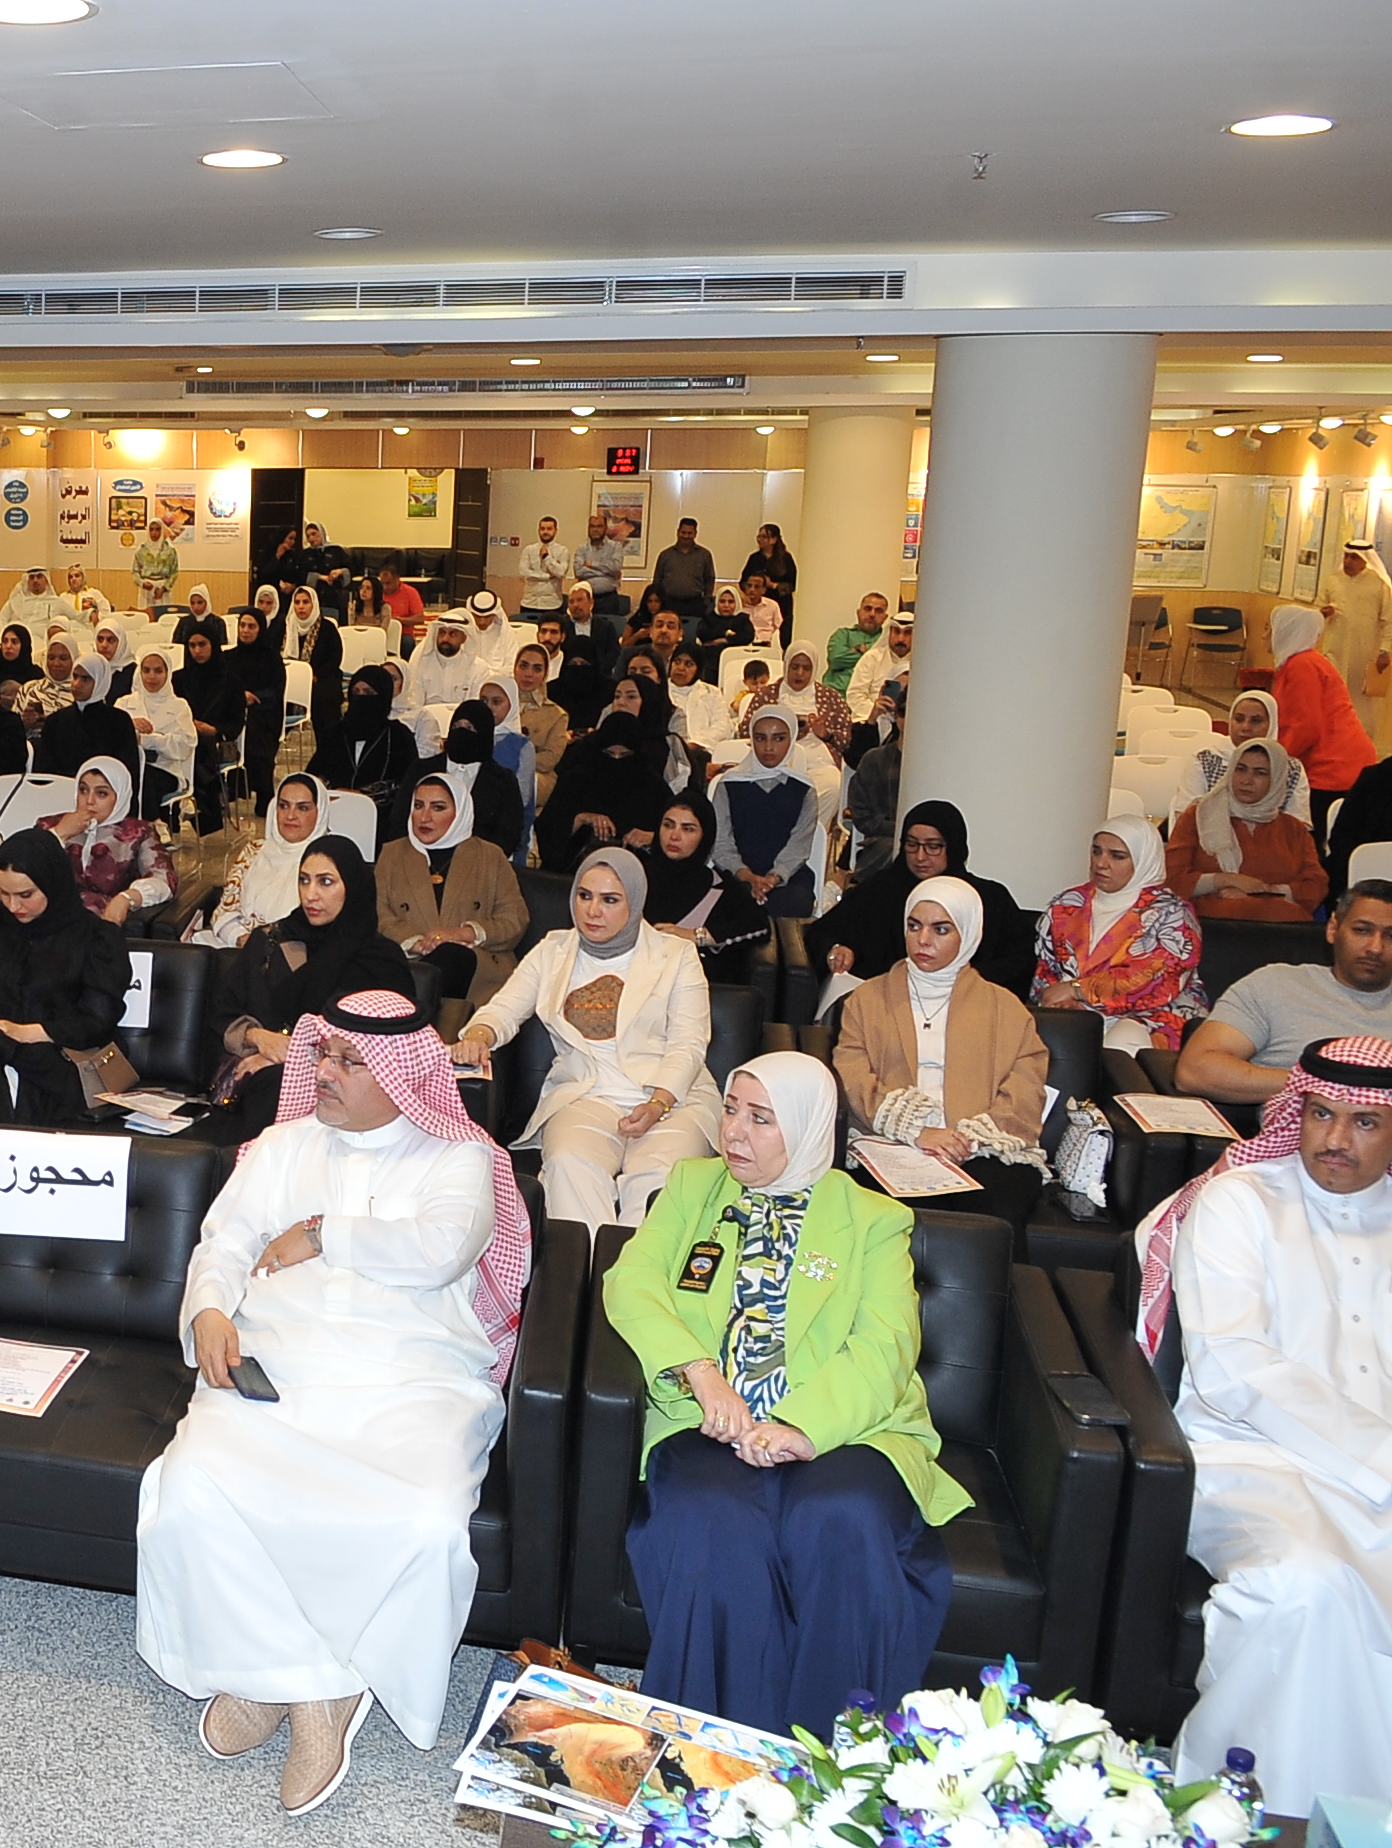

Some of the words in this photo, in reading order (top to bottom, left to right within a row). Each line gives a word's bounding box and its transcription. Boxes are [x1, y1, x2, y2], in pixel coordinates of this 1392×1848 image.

[60, 481, 90, 499] معرض
[59, 506, 90, 525] الرسوم
[59, 530, 90, 548] البيئية
